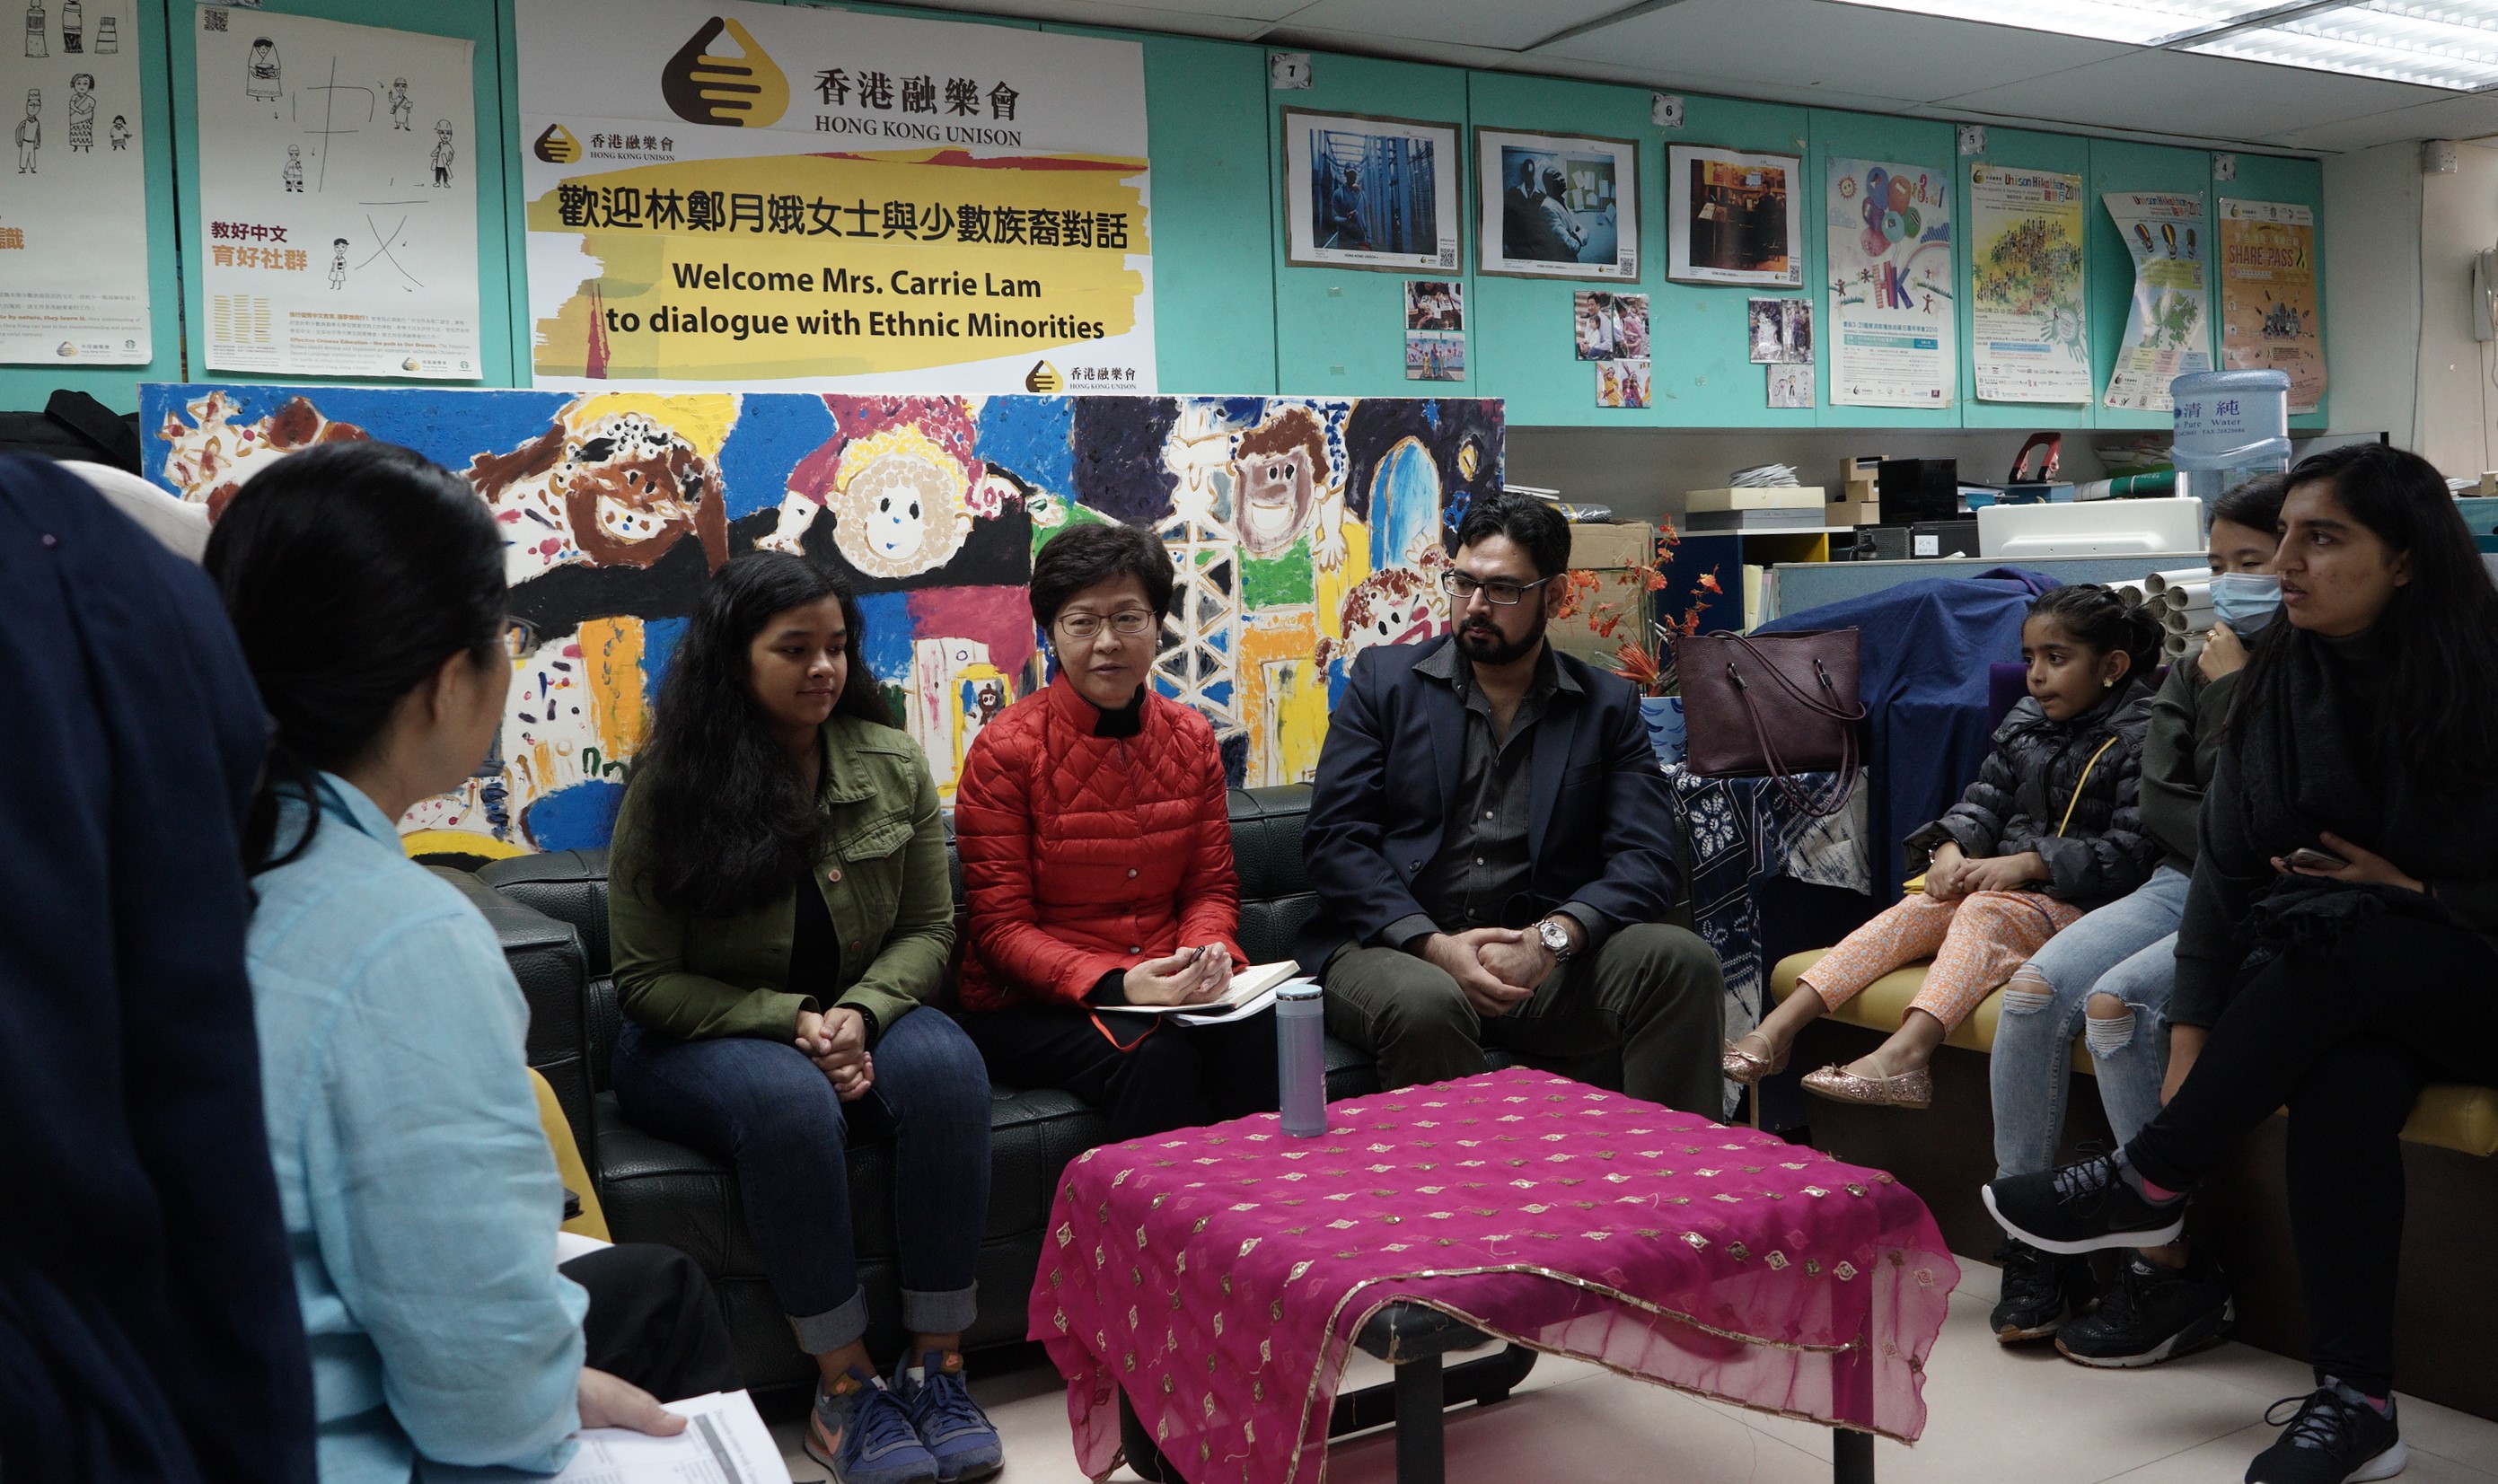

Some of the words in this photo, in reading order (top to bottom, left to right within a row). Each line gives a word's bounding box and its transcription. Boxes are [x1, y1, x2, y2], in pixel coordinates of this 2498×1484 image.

[1288, 65, 1296, 77] 7
[814, 68, 1020, 121] 香港融樂會
[1666, 105, 1673, 117] 6
[590, 133, 674, 152] 香港融樂會
[814, 115, 877, 136] HONG
[884, 119, 941, 141] KONG
[945, 126, 1022, 147] UNISON
[1969, 136, 1975, 145] 5
[590, 151, 616, 159] HONG
[644, 154, 675, 162] UNISON
[2221, 163, 2227, 172] 4
[2005, 173, 2031, 187] Unison
[2032, 176, 2064, 190] Hikathon
[2065, 185, 2080, 202] 2011
[558, 184, 1128, 249] 歡迎林鄭月娥女士與少數族裔對話
[211, 221, 287, 243] 教好中文
[211, 244, 308, 271] 育好社群
[2229, 244, 2263, 265] SHARE
[2268, 247, 2293, 268] PASS
[672, 263, 814, 292] Welcome
[822, 268, 883, 294] Mrs.
[891, 270, 977, 296] Carrie
[985, 273, 1042, 297] Lam
[1872, 260, 1914, 309] HK
[606, 308, 640, 332] to
[649, 305, 788, 341] dialogue
[796, 310, 860, 335] with
[869, 312, 960, 337] Ethnic
[968, 313, 1104, 339] Minorities
[1070, 367, 1136, 381] 香港融樂會
